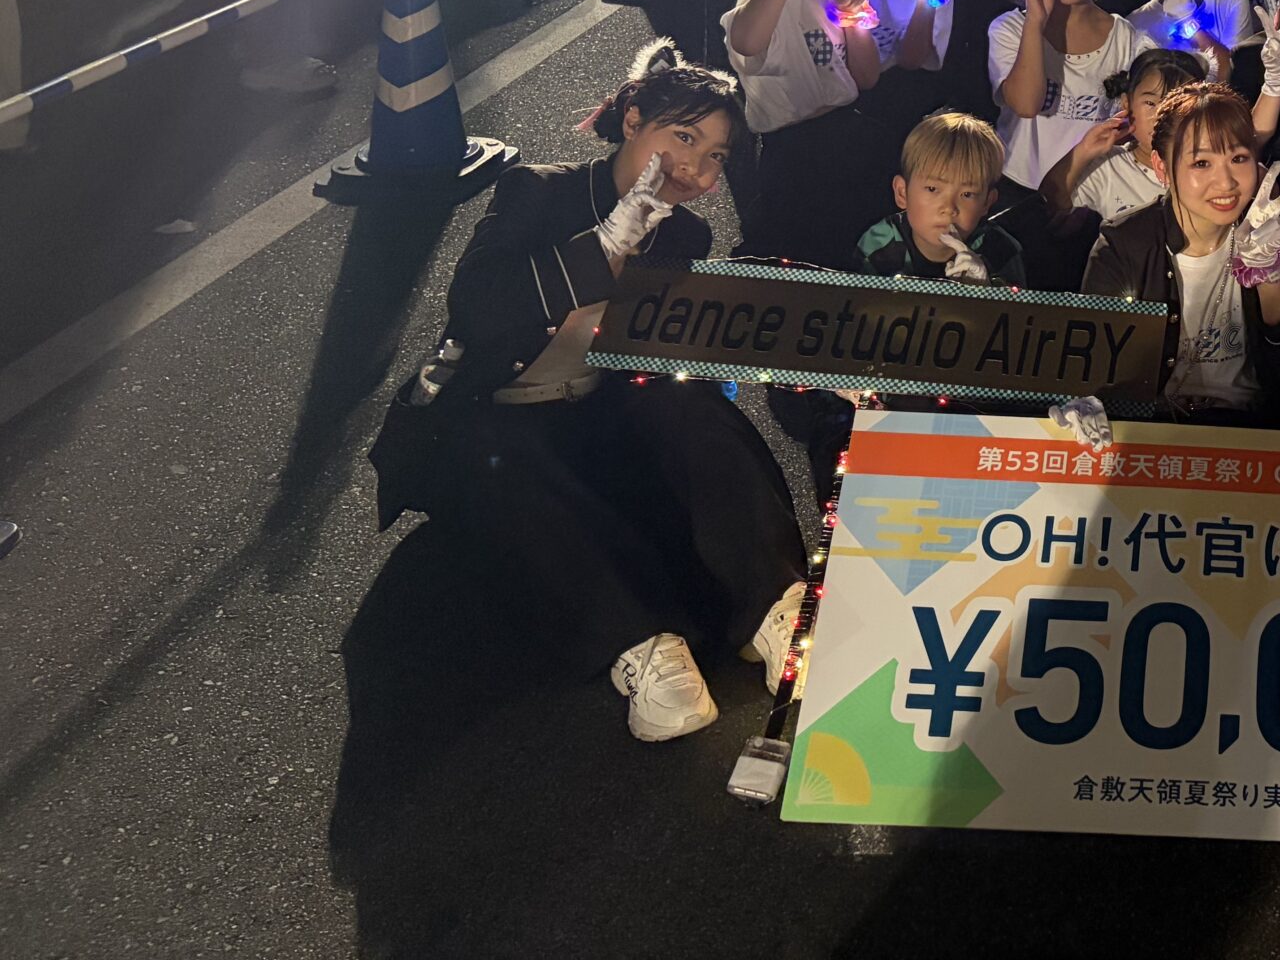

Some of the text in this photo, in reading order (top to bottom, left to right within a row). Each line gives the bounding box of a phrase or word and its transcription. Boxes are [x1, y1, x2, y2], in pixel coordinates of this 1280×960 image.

[626, 282, 787, 353] dance
[796, 299, 967, 370] studio
[974, 313, 1137, 386] AirRY
[976, 444, 1264, 486] 第53回倉敷天領夏祭り
